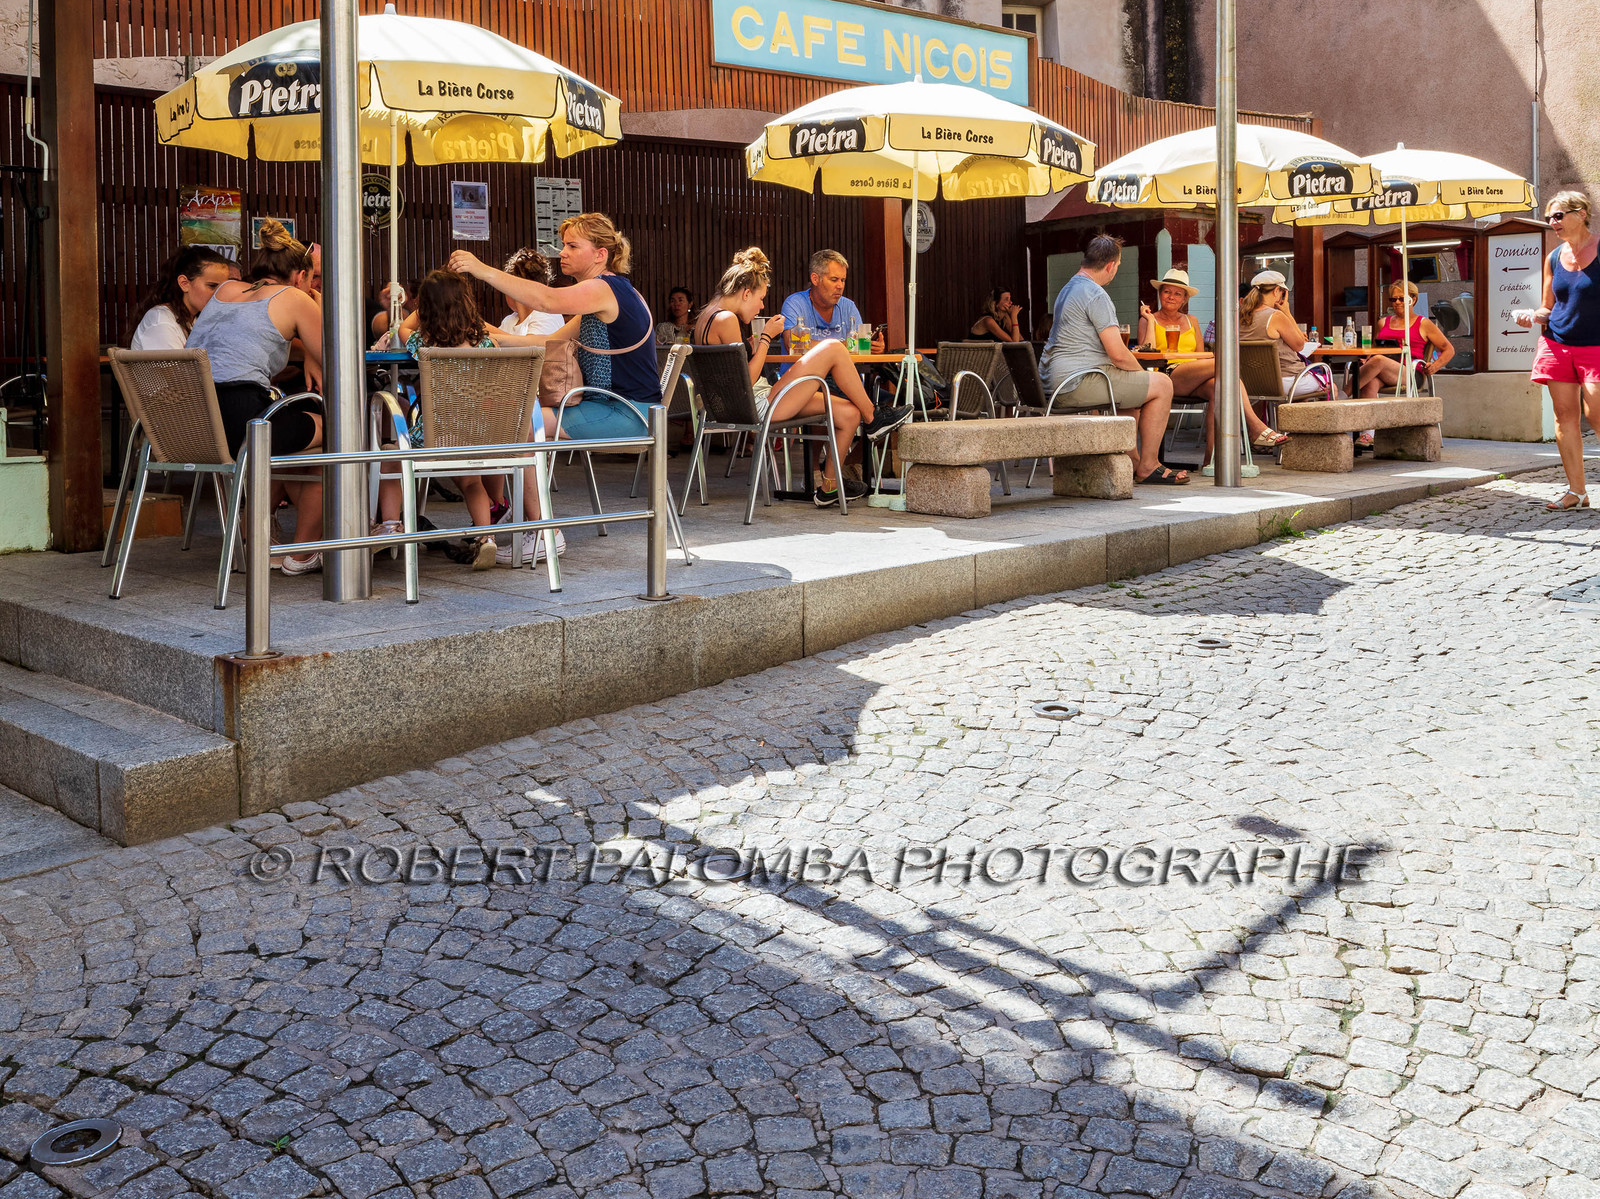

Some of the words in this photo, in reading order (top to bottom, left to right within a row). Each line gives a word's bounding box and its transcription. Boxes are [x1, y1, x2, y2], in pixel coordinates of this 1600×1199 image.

[731, 5, 866, 66] CAFE
[883, 29, 1012, 90] NICOIS
[417, 79, 433, 97] La
[438, 80, 473, 98] Bière
[476, 82, 515, 100] Corse
[567, 91, 602, 131] Pietra
[795, 126, 858, 156] Pietra
[920, 126, 932, 140] La
[935, 127, 962, 142] Bière
[965, 129, 994, 145] Corse
[1043, 137, 1078, 171] Pietra
[1102, 179, 1138, 202] Pietra
[1183, 185, 1193, 195] La
[1292, 173, 1347, 197] Pietra
[1485, 186, 1504, 195] Corse
[361, 191, 391, 208] ietr
[1495, 244, 1540, 258] Domino
[1499, 283, 1532, 292] Création
[1510, 296, 1521, 305] de
[1496, 345, 1518, 353] Entrée
[1519, 344, 1536, 353] libre
